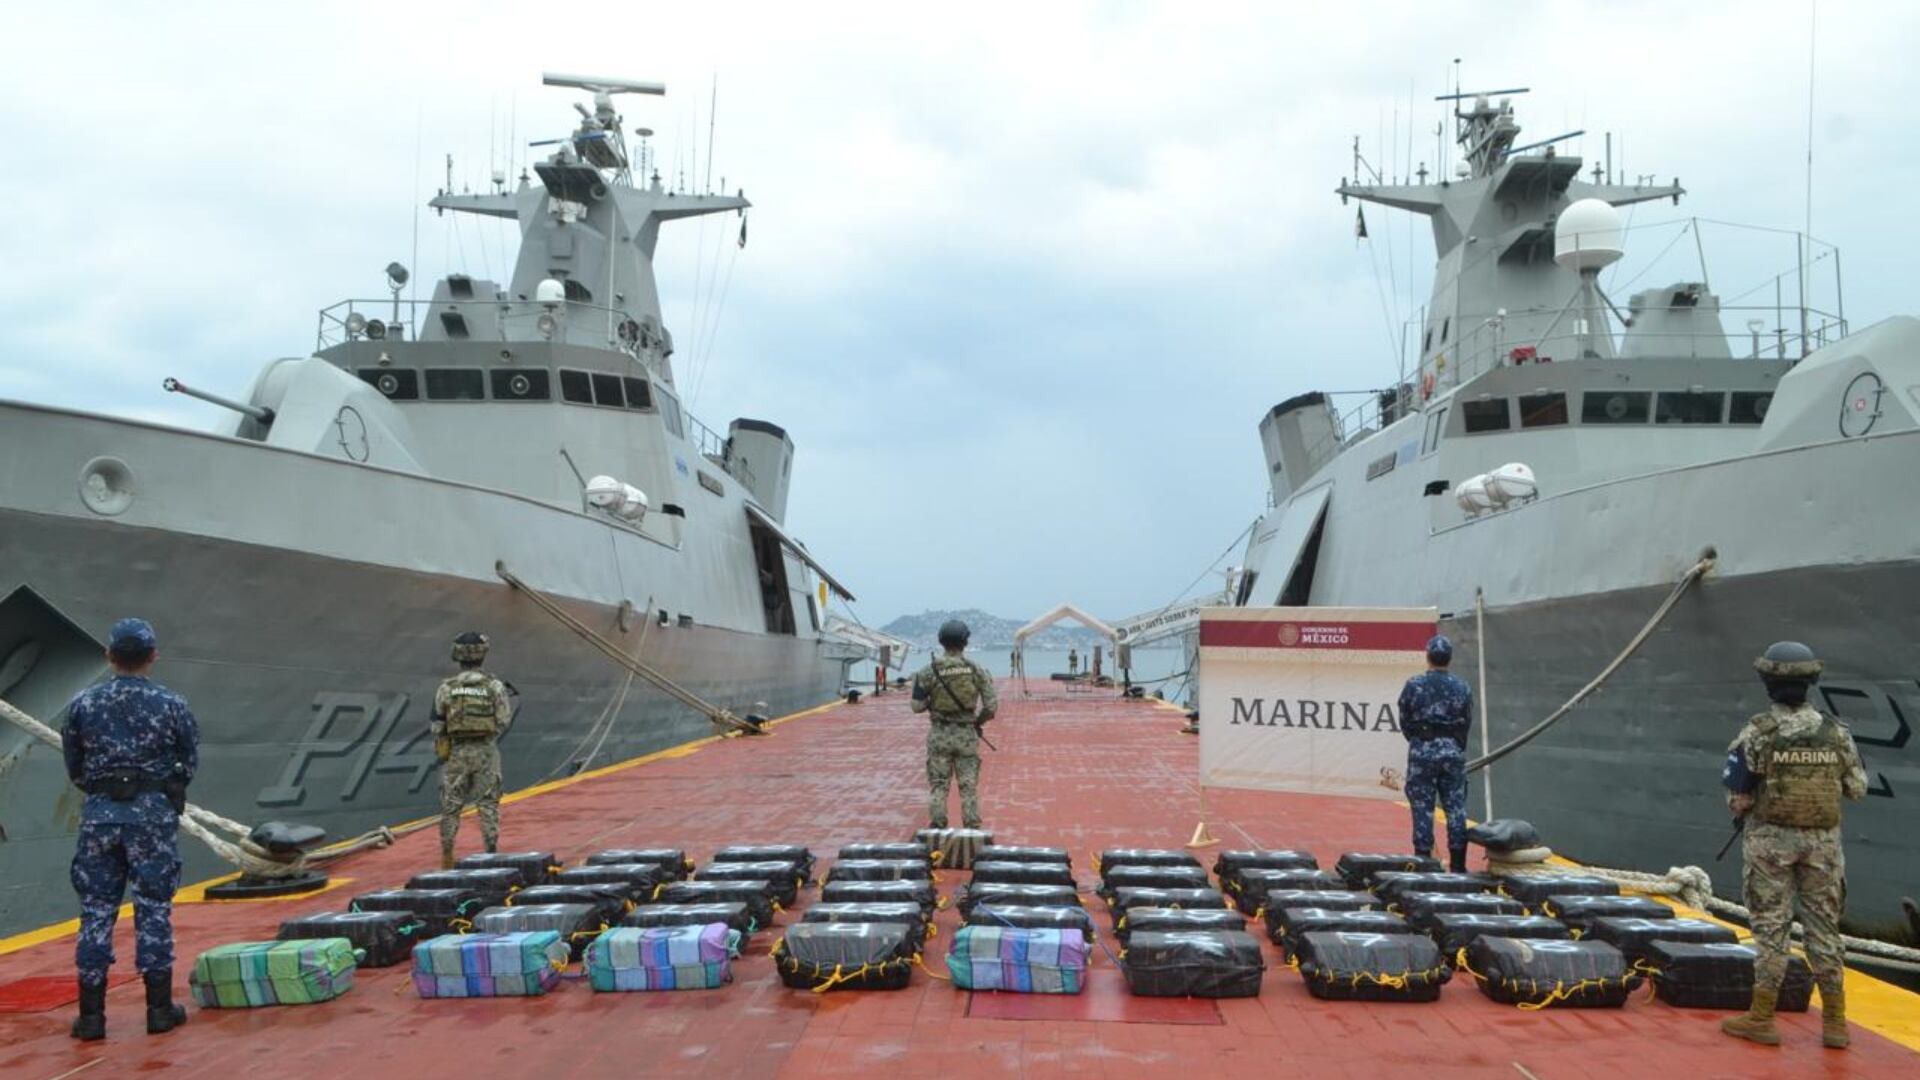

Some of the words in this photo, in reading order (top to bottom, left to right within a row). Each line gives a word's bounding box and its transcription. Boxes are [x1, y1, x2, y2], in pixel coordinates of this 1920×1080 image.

[1302, 632, 1349, 644] MÉXICO
[451, 687, 488, 696] MARINA
[1230, 697, 1401, 733] MARINA
[1815, 680, 1920, 798] P
[256, 691, 521, 807] P14
[1773, 750, 1839, 764] MARINA
[1418, 892, 1504, 903] 26
[305, 911, 384, 921] 10
[1142, 907, 1226, 922] 15
[1302, 908, 1388, 921] 16
[828, 923, 871, 938] 4
[1521, 938, 1579, 953] 8
